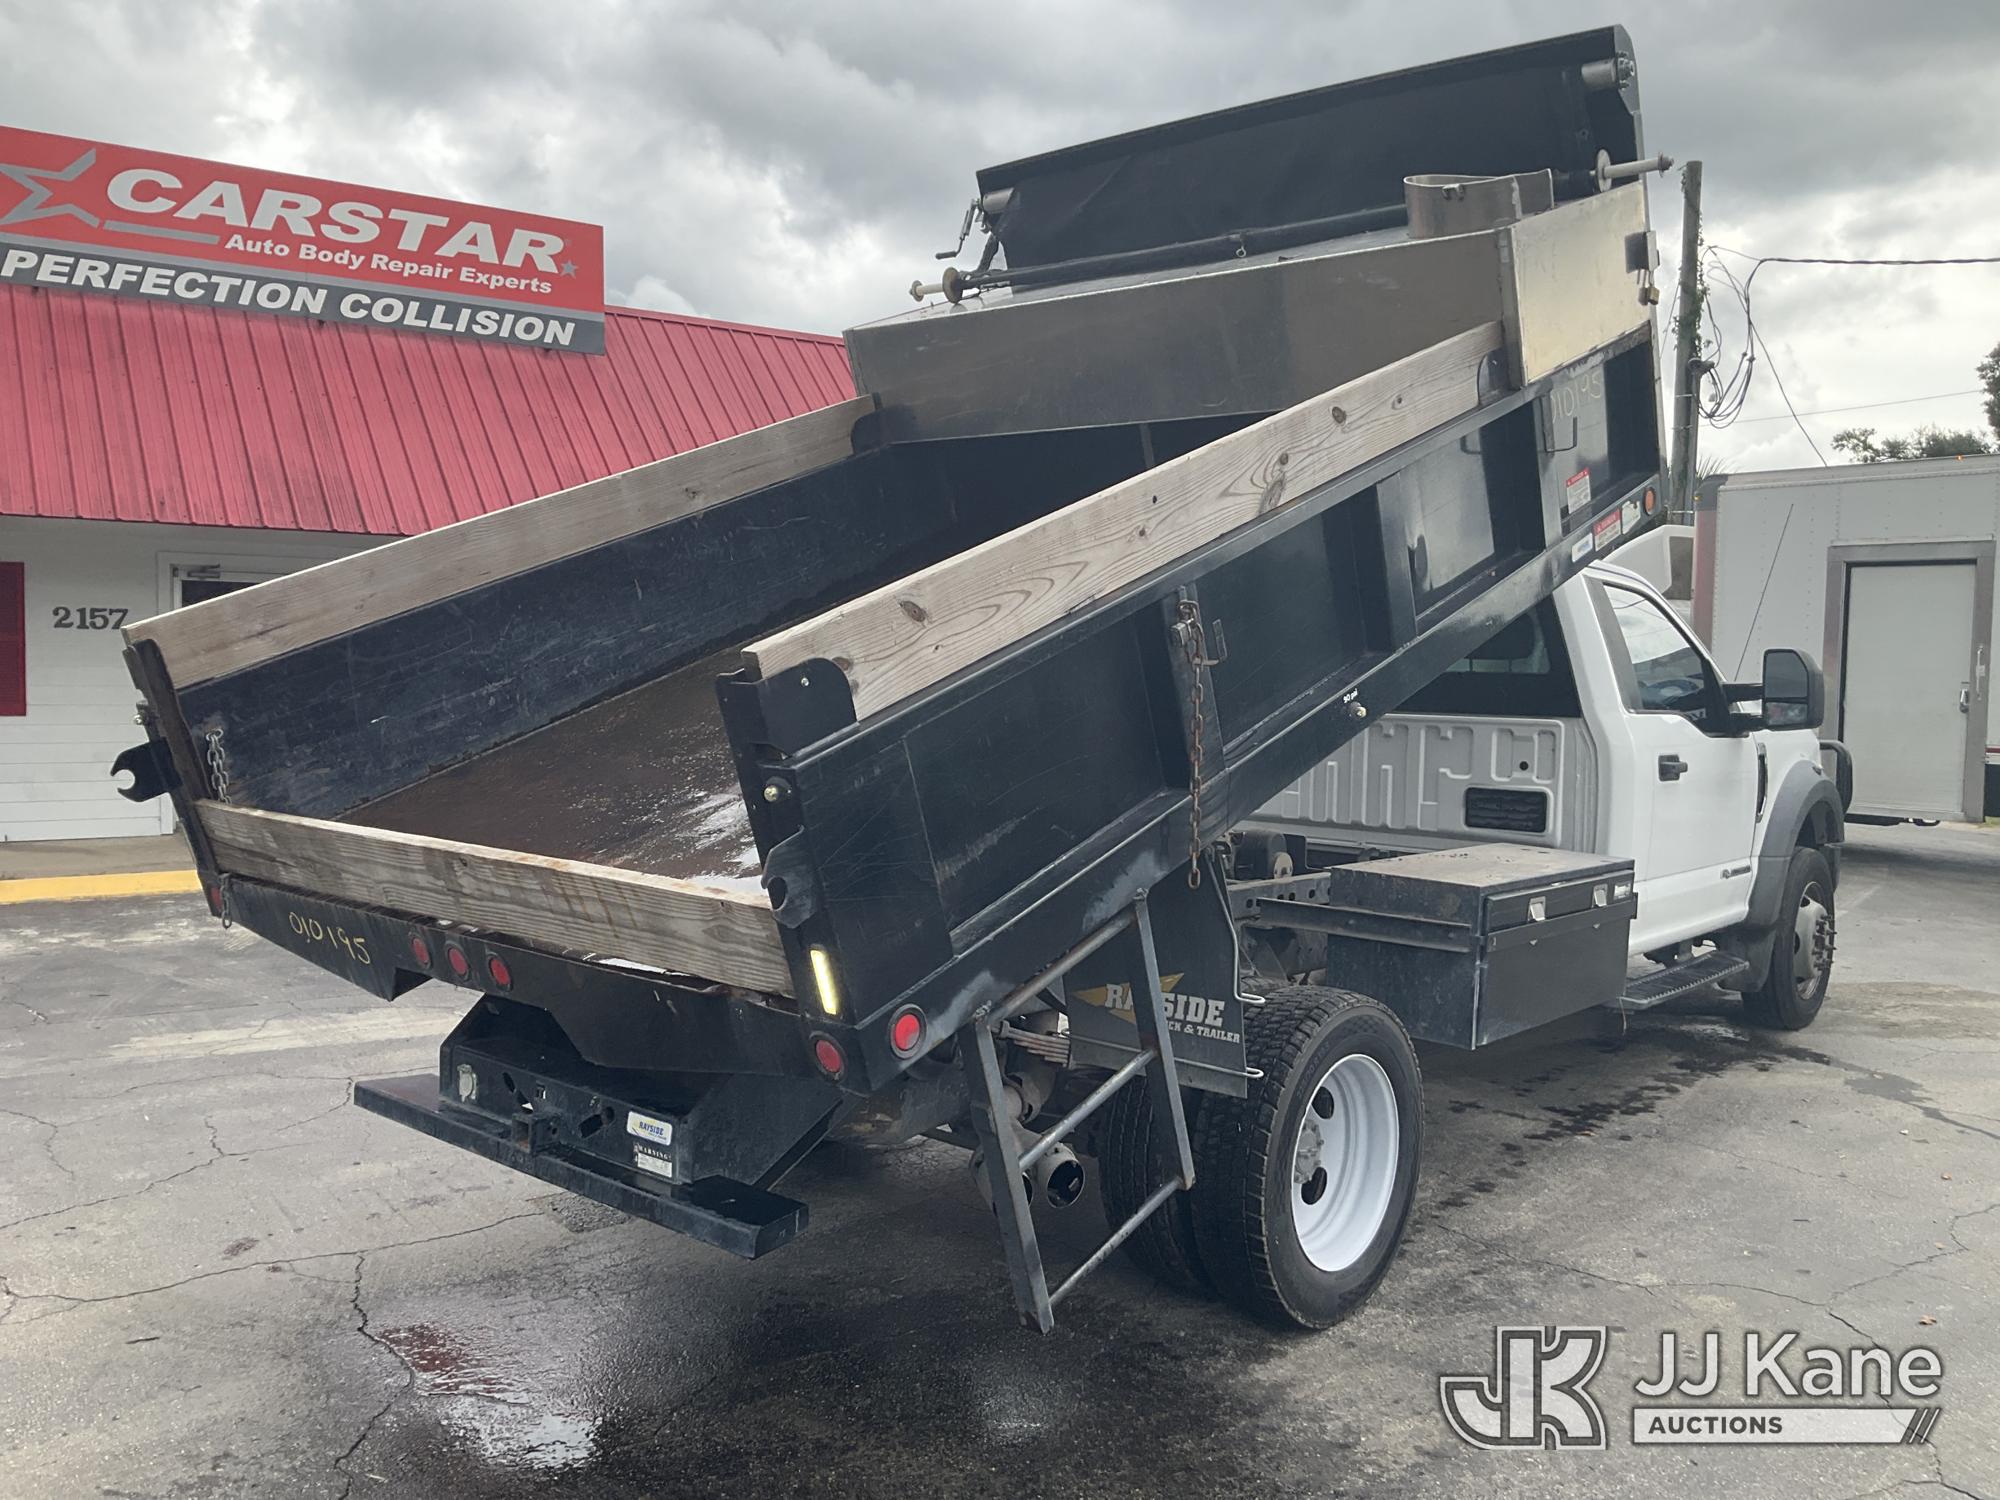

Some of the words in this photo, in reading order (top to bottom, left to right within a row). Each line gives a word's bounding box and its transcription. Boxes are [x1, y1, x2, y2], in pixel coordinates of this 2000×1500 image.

[107, 168, 564, 273] CARSTAR
[224, 234, 290, 257] Auto
[299, 244, 366, 271] Body
[370, 253, 453, 280] Repair
[459, 268, 553, 294] Experts
[1, 249, 327, 314] PERFECTION
[340, 293, 575, 347] COLLISION
[53, 606, 129, 630] 2157
[1183, 1024, 1195, 1035] &
[1197, 1026, 1241, 1044] TRAILER
